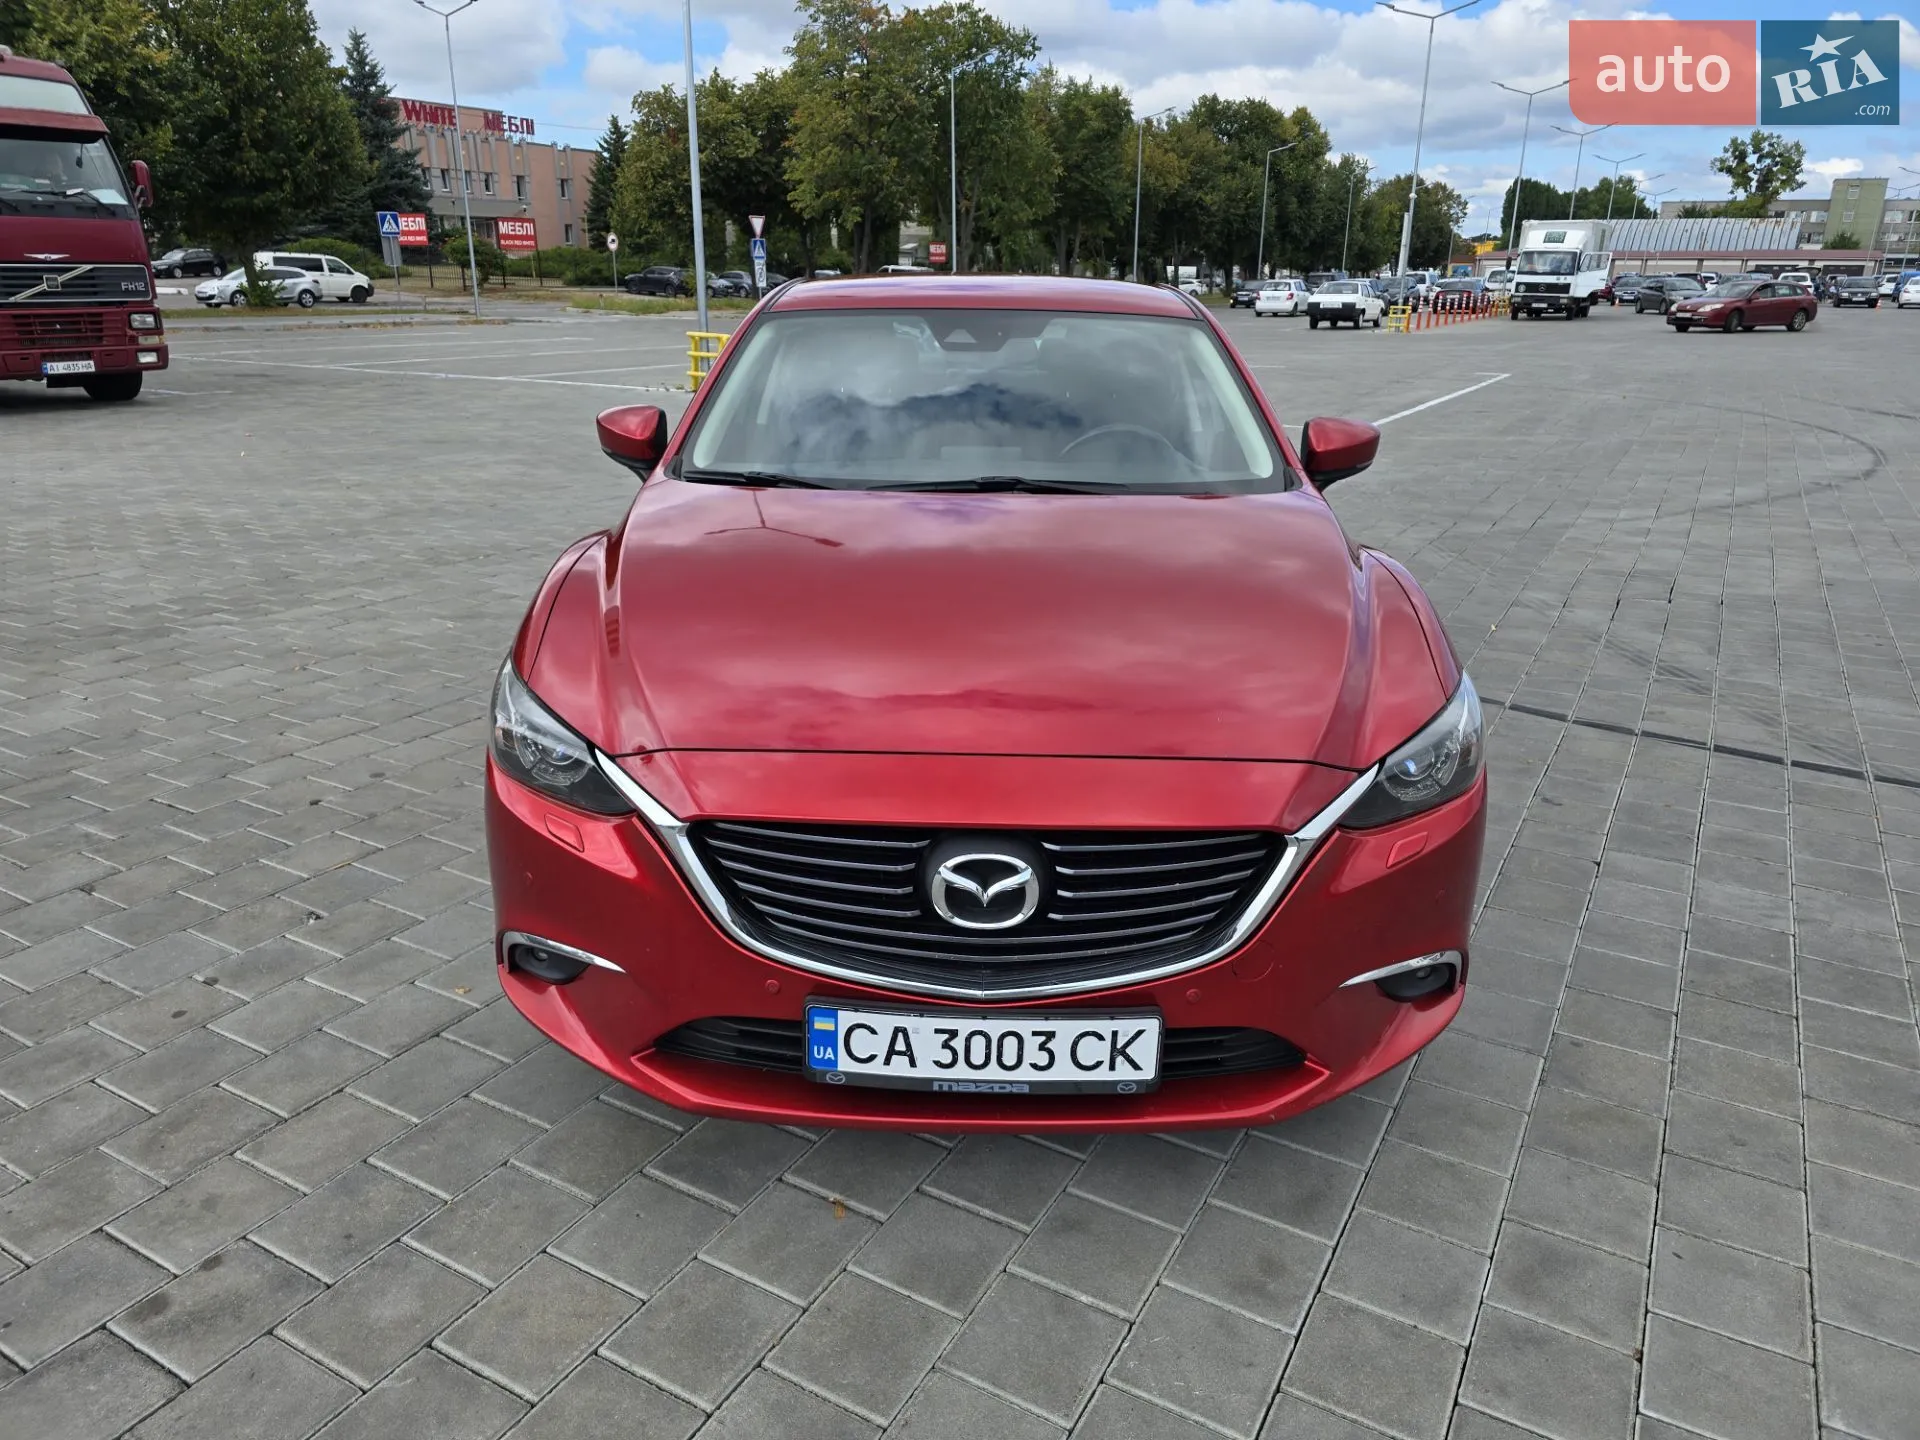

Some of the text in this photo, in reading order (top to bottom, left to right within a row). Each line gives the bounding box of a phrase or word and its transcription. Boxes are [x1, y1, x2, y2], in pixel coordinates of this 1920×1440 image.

[499, 221, 534, 235] МЕБЛІ
[121, 282, 146, 291] FH12
[813, 1045, 836, 1061] UA
[843, 1022, 1147, 1072] CA 3003 CK
